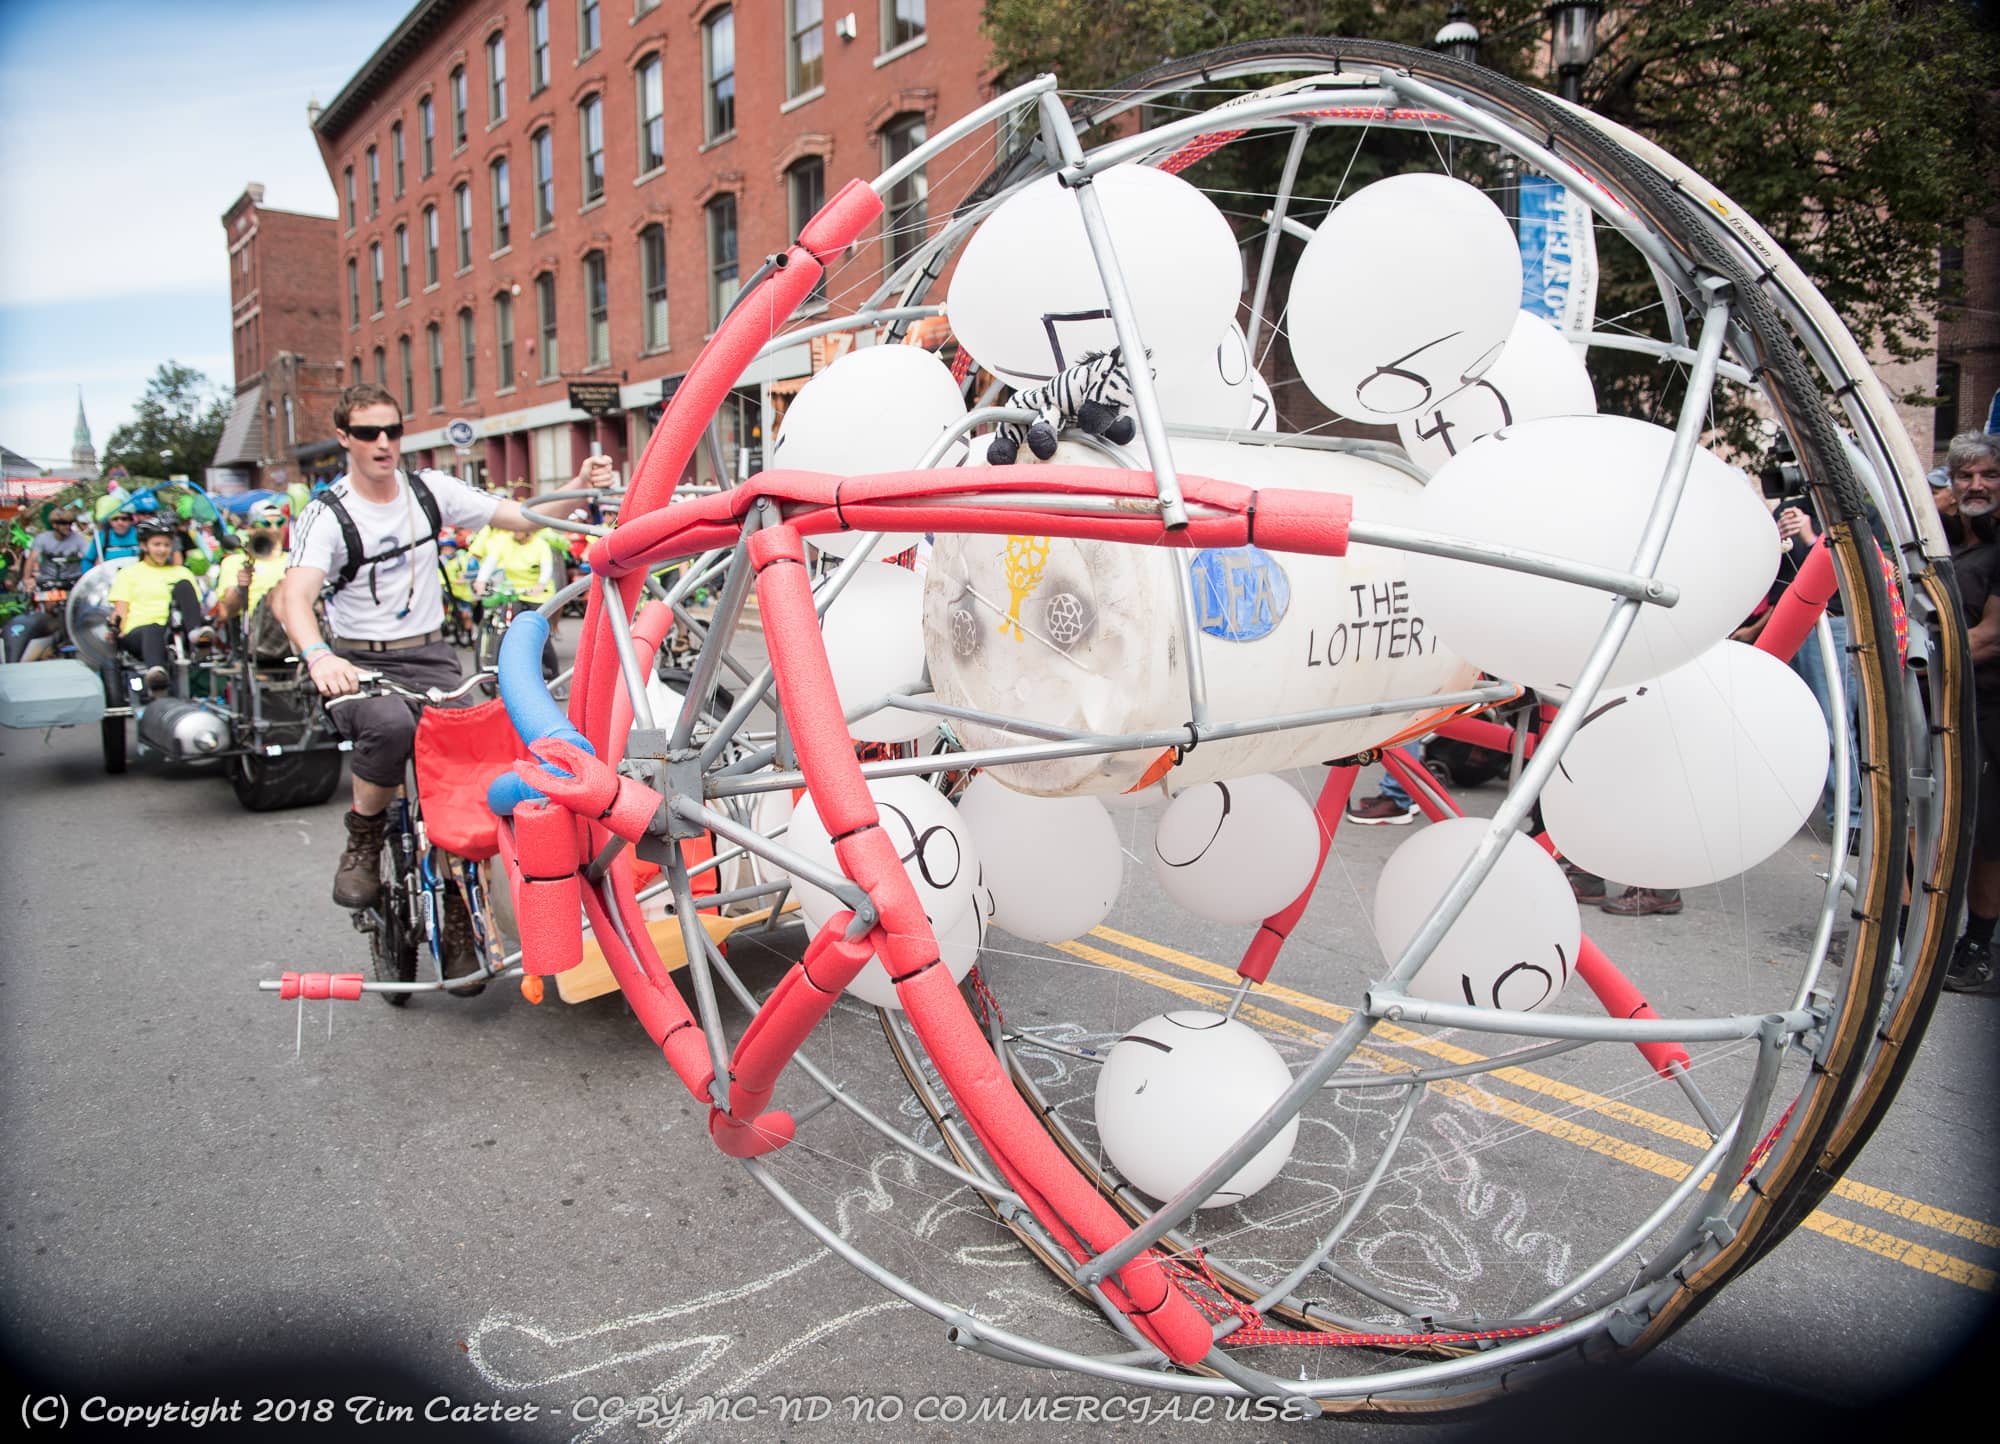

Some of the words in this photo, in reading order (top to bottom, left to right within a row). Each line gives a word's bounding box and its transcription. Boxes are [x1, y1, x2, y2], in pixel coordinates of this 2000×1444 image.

[1543, 192, 1571, 330] LOWELL
[1192, 554, 1280, 633] LFA
[1350, 580, 1410, 618] THE
[1307, 617, 1437, 667] LOTTER
